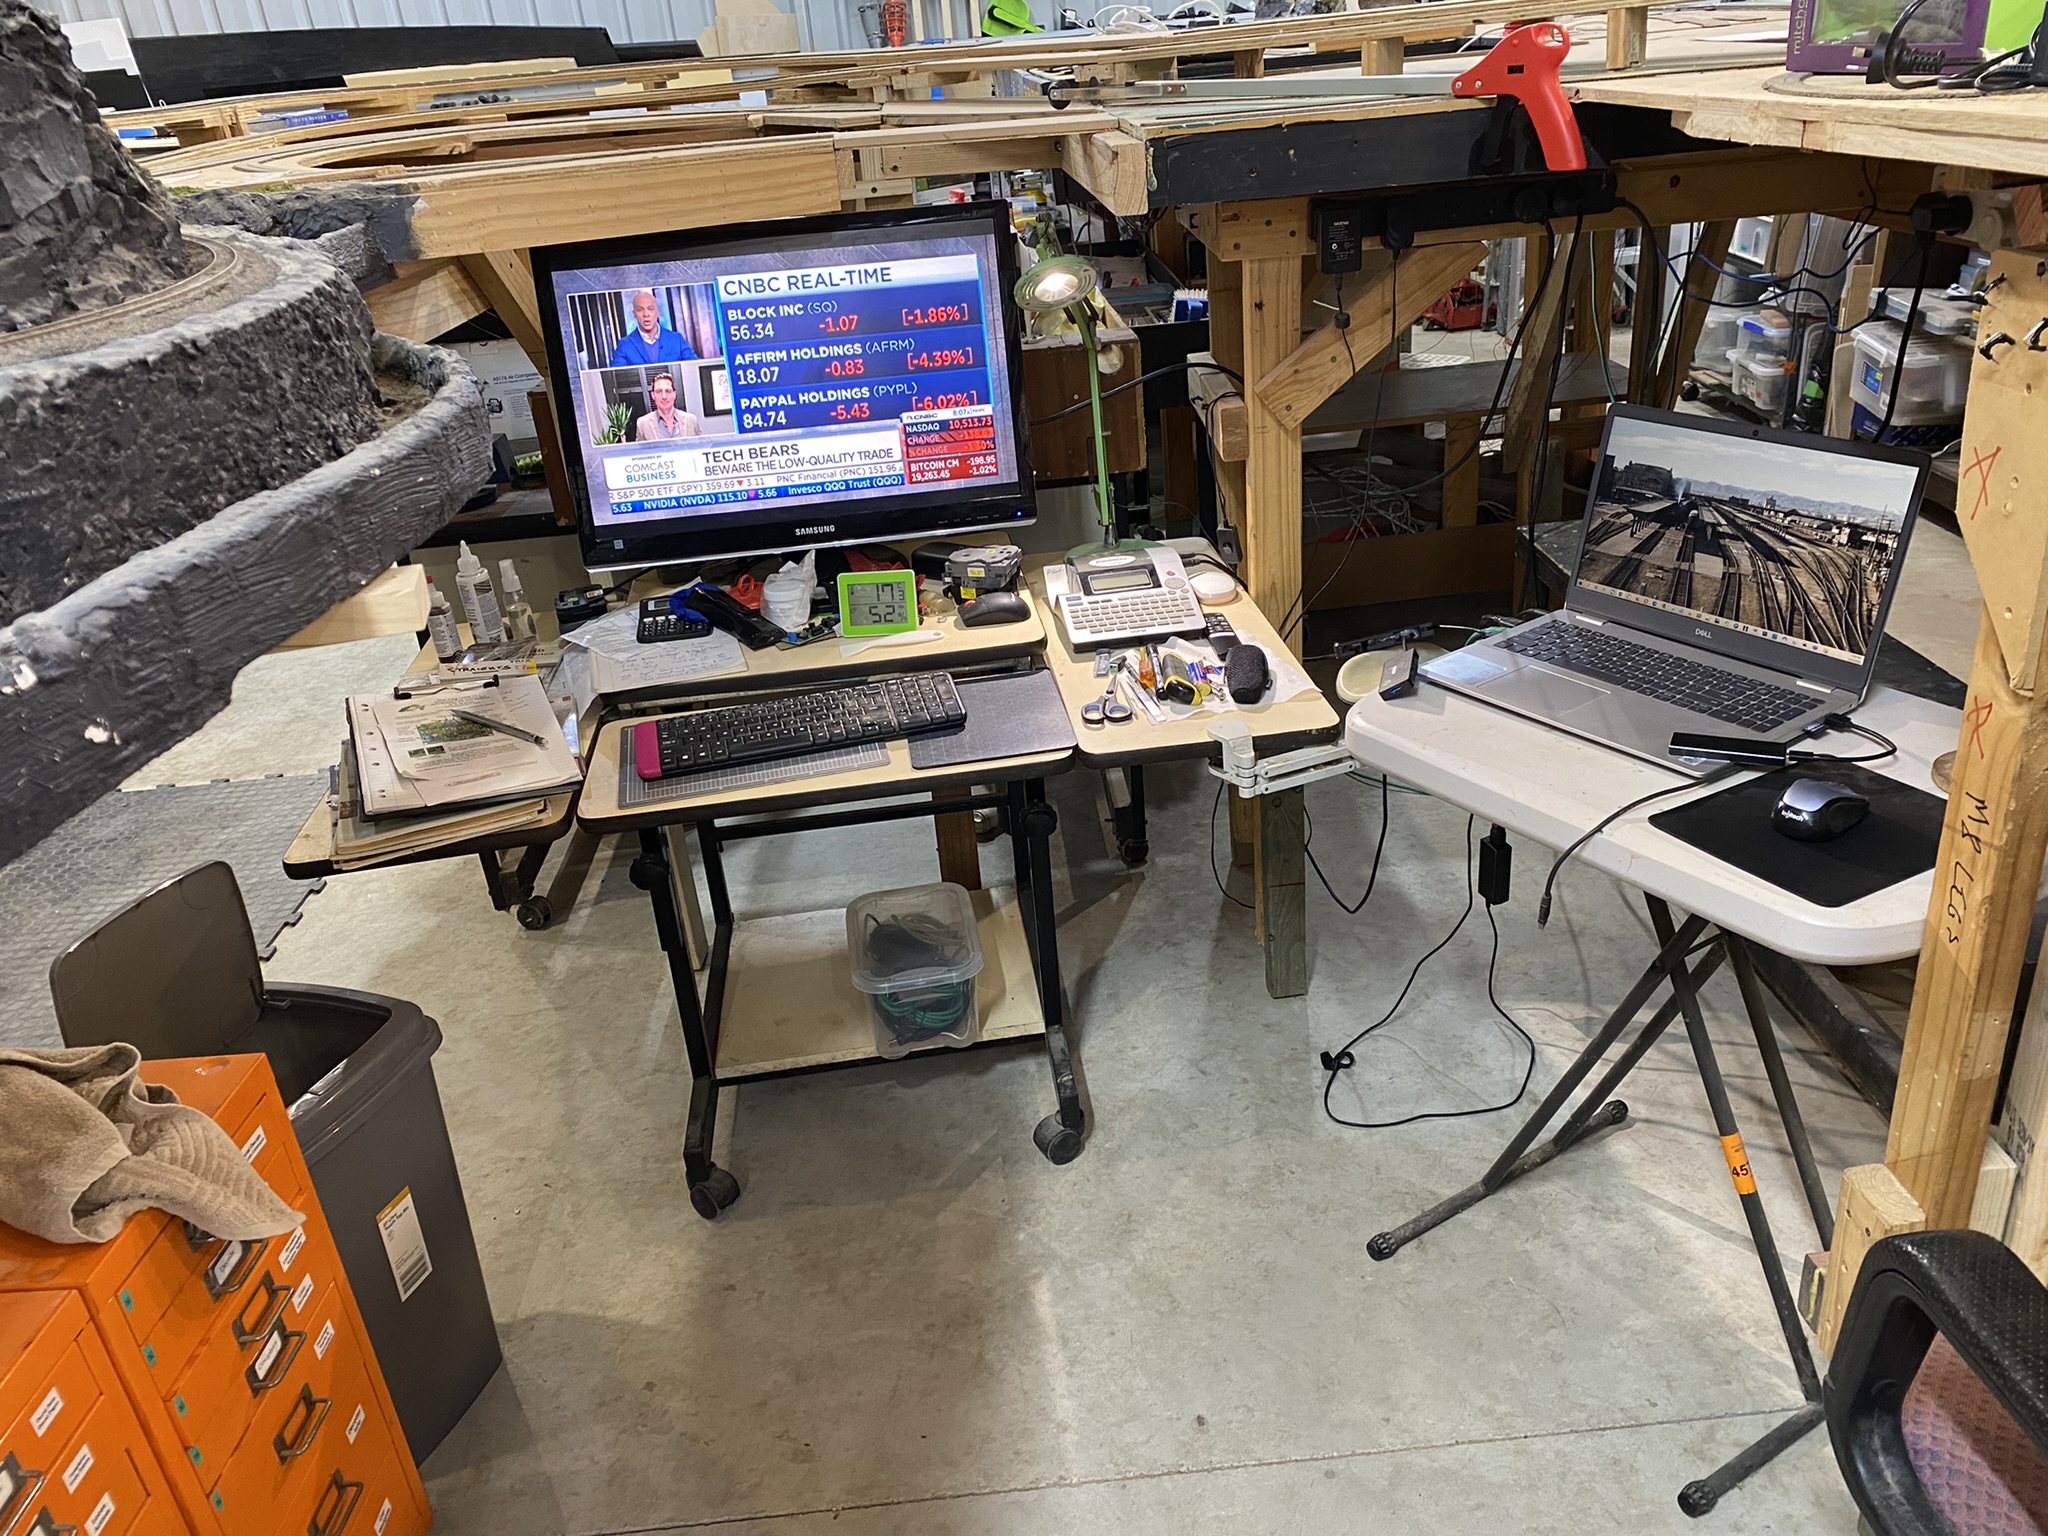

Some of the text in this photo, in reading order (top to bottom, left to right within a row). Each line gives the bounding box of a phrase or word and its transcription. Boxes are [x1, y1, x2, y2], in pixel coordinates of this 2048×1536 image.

[724, 267, 892, 296] CNBC REAL-TIME
[728, 300, 837, 321] BLOCK INC (SQ)
[730, 303, 968, 340] 56.34 -1.07 [-1.86%]
[735, 338, 914, 365] AFFIRM HOLDINGS (AFRM)
[737, 347, 973, 385] 18.07 -0.83 [-4.39%]
[740, 382, 917, 410] PAYPAL HOLDINGS (PYPL)
[743, 391, 977, 428] 84.74 -5.43 [-6.02%]
[906, 416, 992, 433] NASDAQ 10,513.73
[907, 435, 940, 445] CHANGE
[702, 444, 799, 464] TECH BEARS
[704, 448, 893, 476] BEWARE THE LOW-QUALITY TRADE
[910, 455, 996, 472] BITCOIN CM -198.95
[625, 460, 674, 474] COMCAST
[627, 470, 676, 483] BUSINESS
[777, 464, 897, 483] PNC Financial (PNC) 151.96
[911, 465, 996, 481] 19,263.45 -1.02%
[613, 476, 902, 512] 5.63 NVIDIA (NVDA) 115.10 5.66 Invesco QQQ Trust (QQQ)
[617, 490, 635, 500] S&P
[638, 488, 654, 498] 500
[657, 487, 673, 496] ETF
[677, 484, 703, 495] (SPY)
[706, 480, 735, 491] 359.69
[746, 478, 765, 487] 3.11
[795, 524, 836, 536] SAMSUNG
[869, 605, 895, 623] 52
[1695, 628, 1712, 638] DELL
